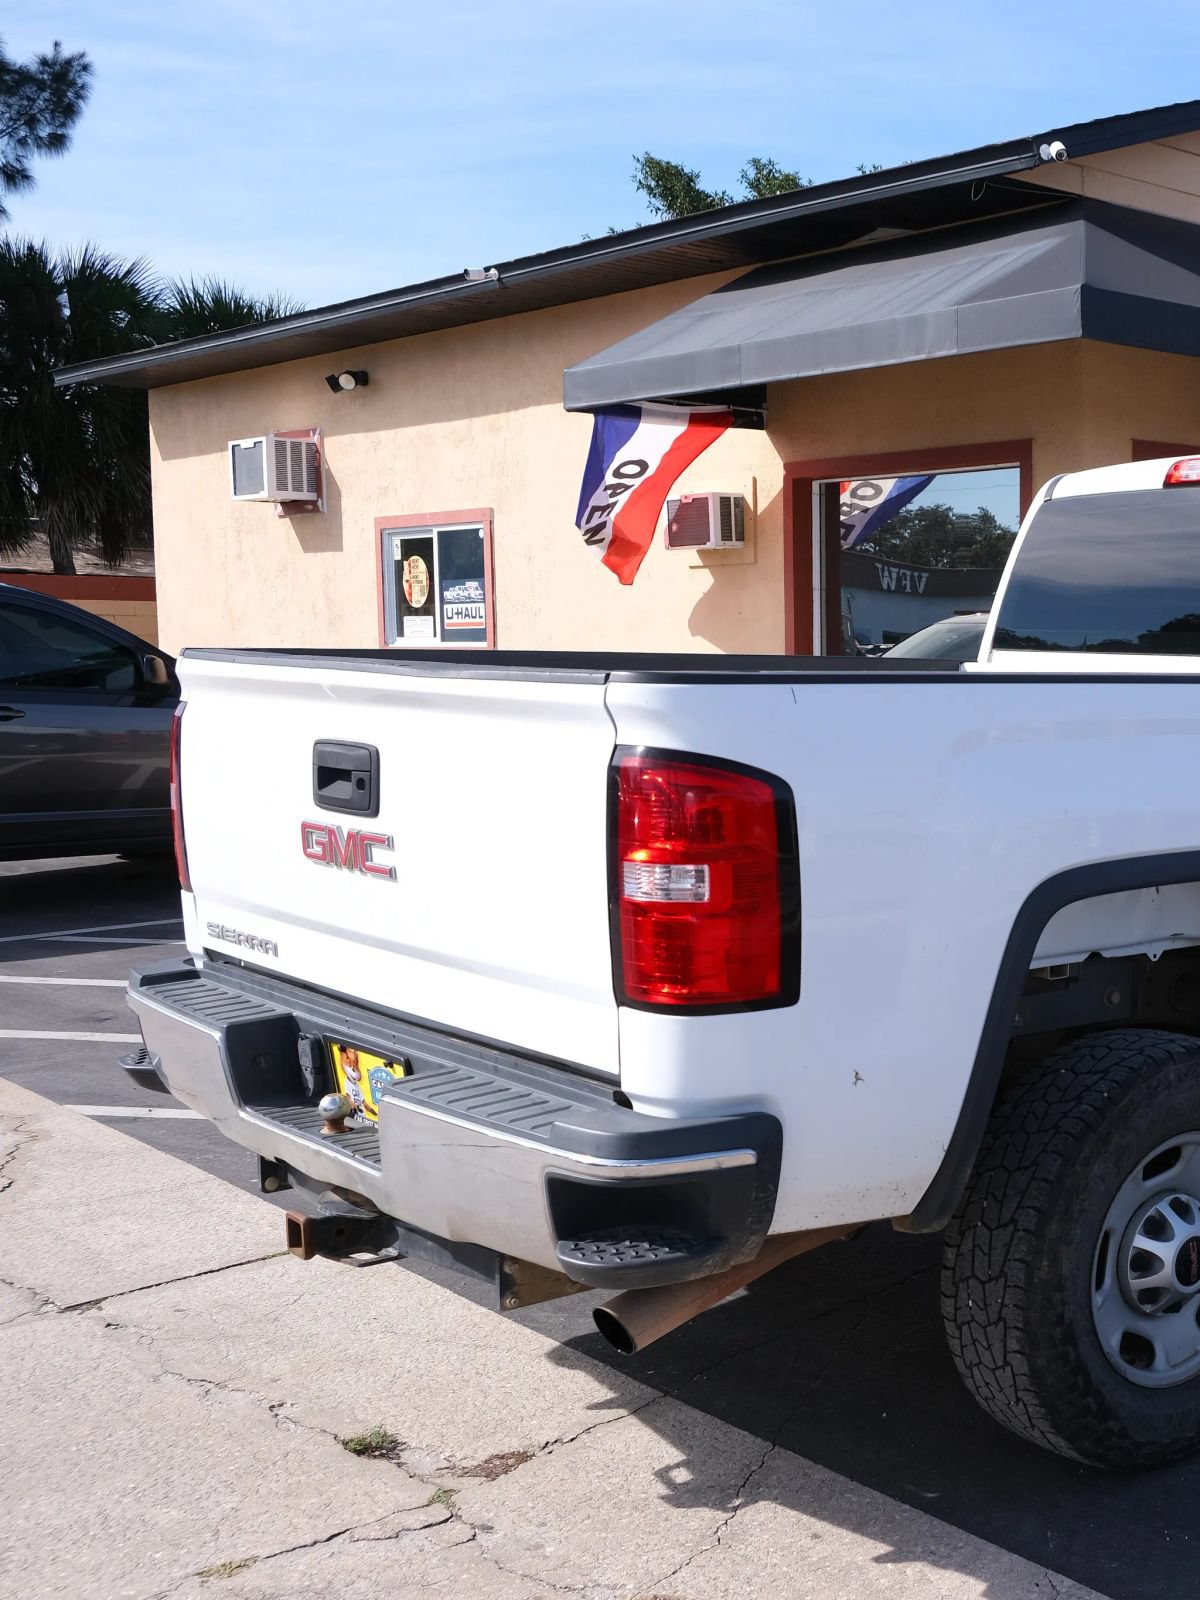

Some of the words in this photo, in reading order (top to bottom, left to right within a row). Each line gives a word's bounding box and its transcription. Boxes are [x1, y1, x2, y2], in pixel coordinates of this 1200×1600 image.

[582, 459, 649, 546] OPEN
[300, 820, 399, 882] GMC
[206, 921, 279, 958] SIERRA
